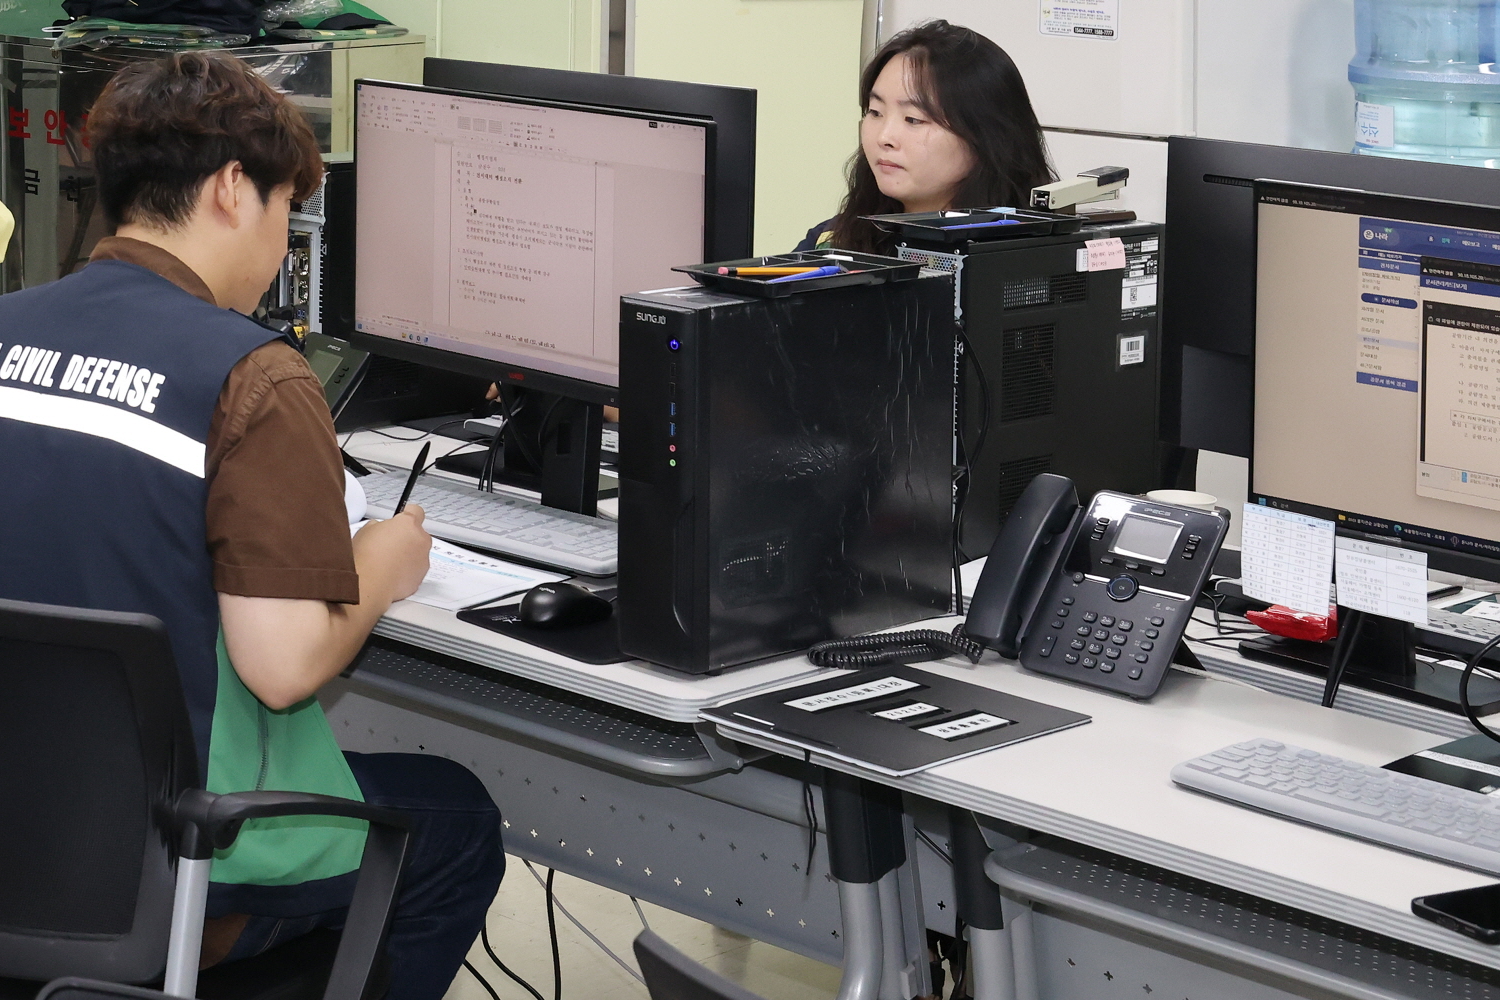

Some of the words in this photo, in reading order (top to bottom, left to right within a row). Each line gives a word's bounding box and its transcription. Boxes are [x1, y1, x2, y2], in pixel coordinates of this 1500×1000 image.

[1374, 231, 1388, 241] 나라
[0, 345, 61, 387] CIVIL
[59, 354, 166, 413] DEFENSE
